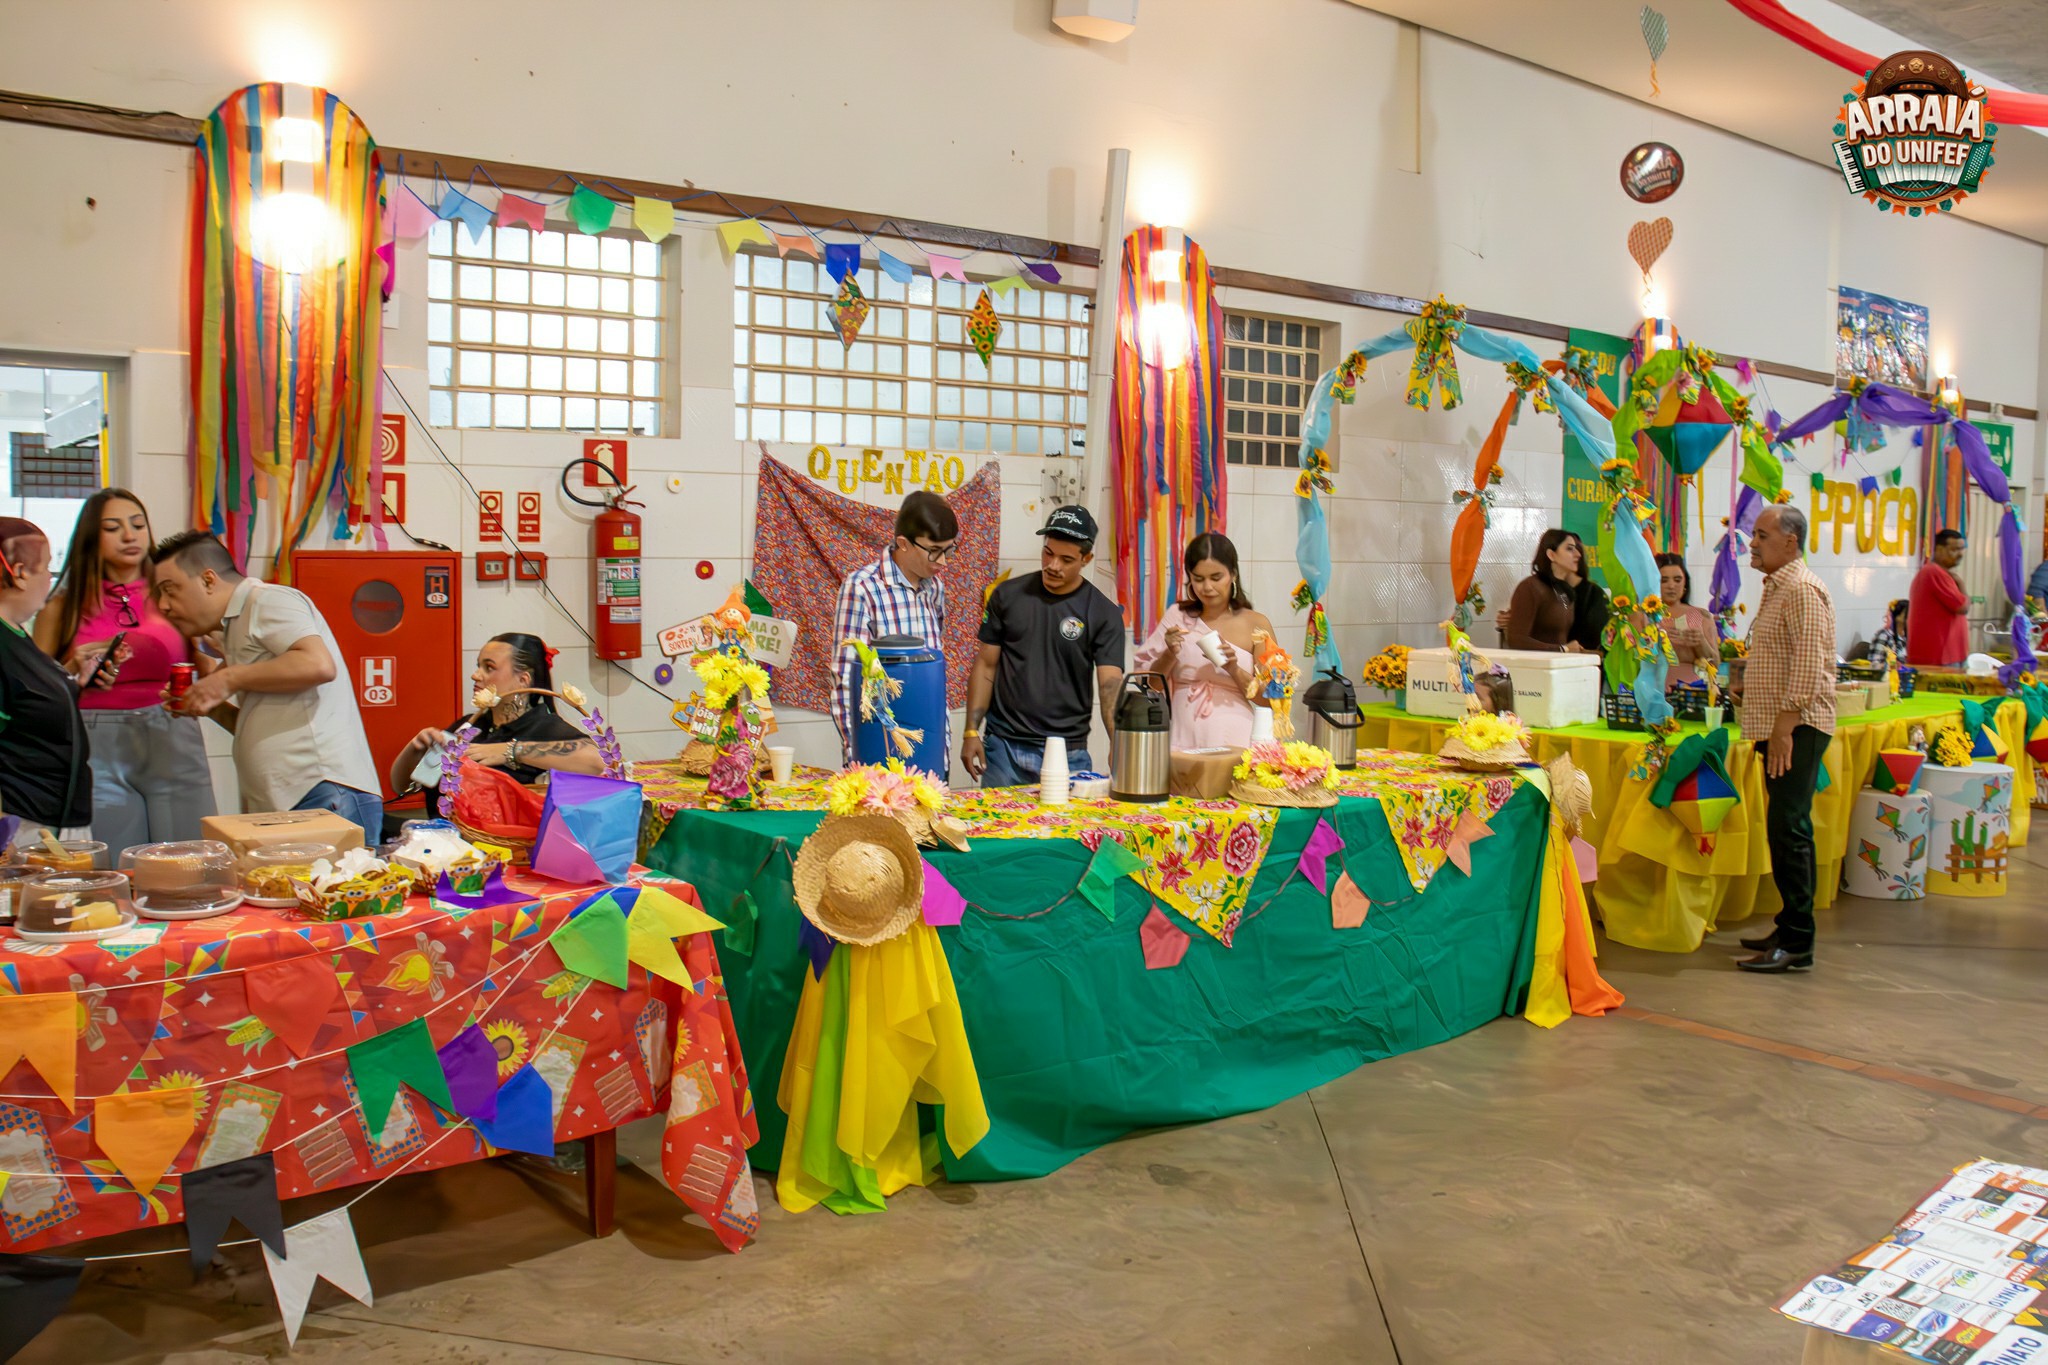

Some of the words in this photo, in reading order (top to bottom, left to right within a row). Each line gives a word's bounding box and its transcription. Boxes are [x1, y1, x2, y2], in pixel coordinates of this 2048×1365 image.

[807, 444, 965, 495] QUENTÃO
[430, 576, 444, 593] H
[431, 594, 445, 603] 03
[365, 659, 393, 687] H
[1412, 679, 1449, 693] MULTI
[368, 690, 389, 701] 03
[1988, 1283, 2029, 1308] PINATO
